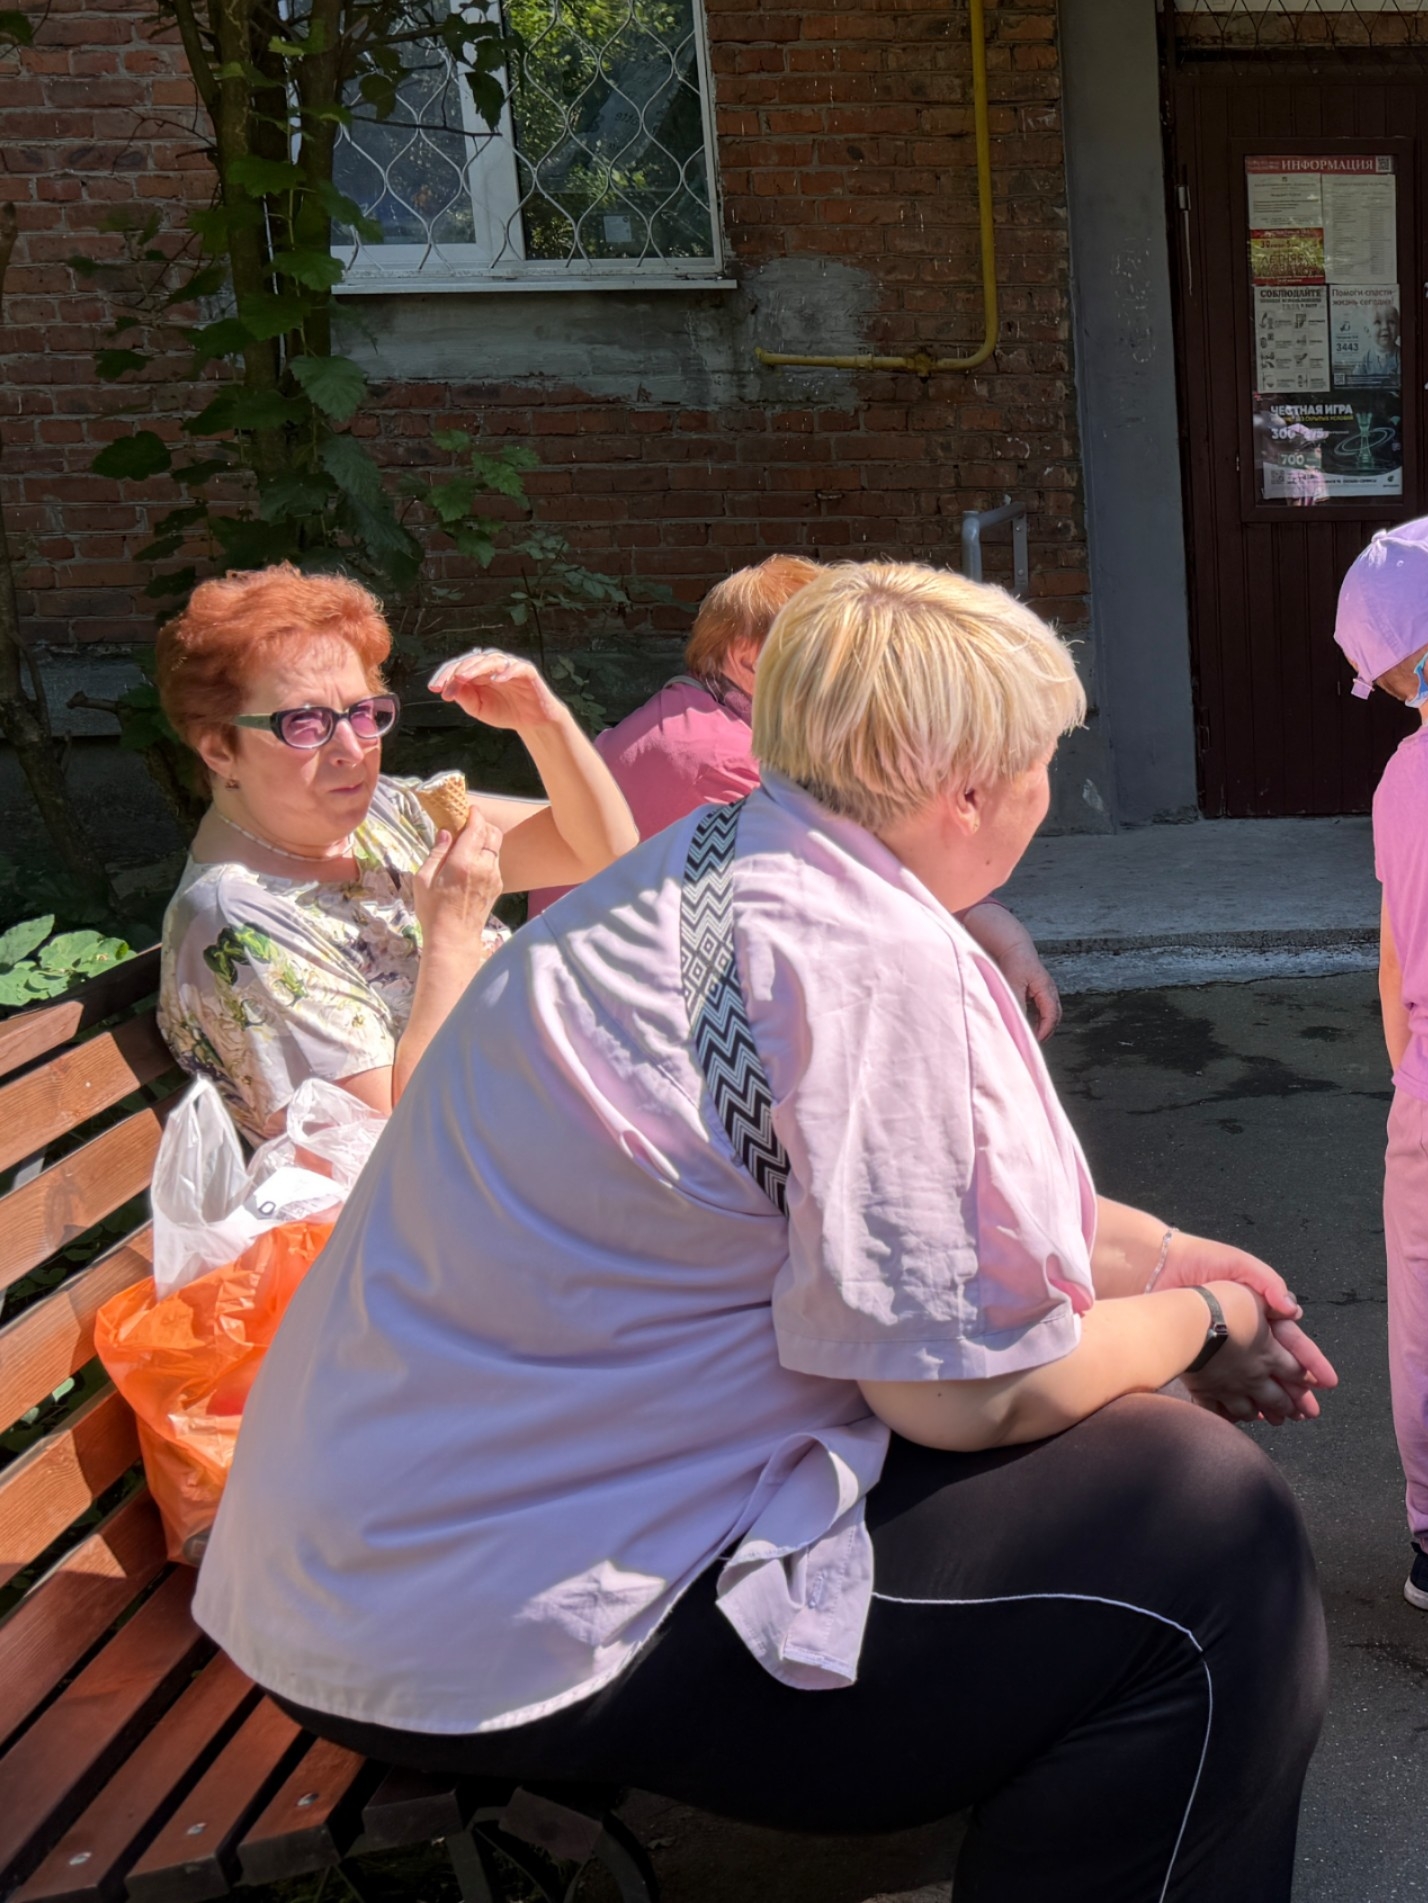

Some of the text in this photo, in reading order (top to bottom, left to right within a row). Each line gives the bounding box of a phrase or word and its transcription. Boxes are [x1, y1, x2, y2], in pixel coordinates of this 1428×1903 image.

[1281, 160, 1374, 171] ИНФОРМАЦИЯ
[1260, 288, 1321, 298] СОБЛЮДАЙТЕ
[1332, 289, 1363, 297] Помоги
[1336, 343, 1359, 352] 3443
[1270, 404, 1353, 415] ЧЕСТНАЯ ИГРА
[1281, 455, 1305, 465] 700
